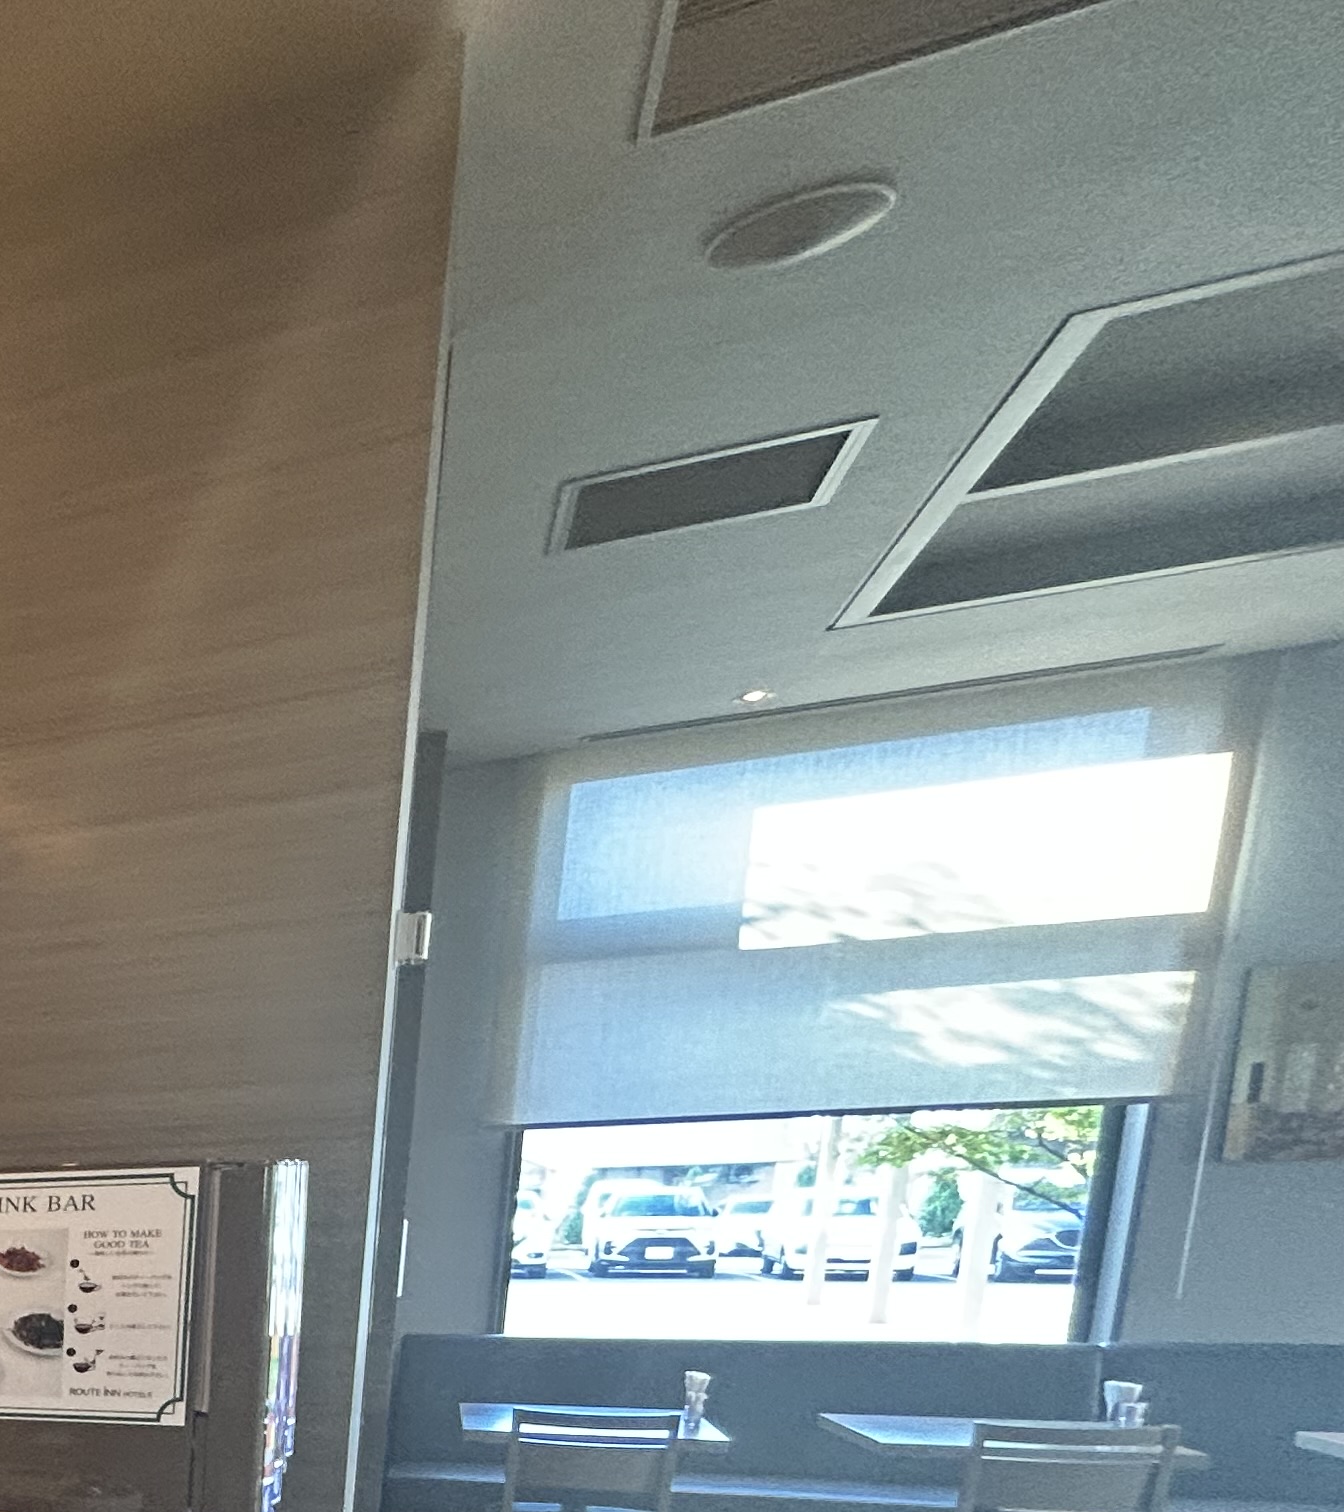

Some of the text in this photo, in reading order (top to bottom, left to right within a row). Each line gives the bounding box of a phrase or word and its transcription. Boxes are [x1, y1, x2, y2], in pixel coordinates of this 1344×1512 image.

[48, 1193, 97, 1213] BAR
[83, 1229, 162, 1239] HOW TO MAKE
[94, 1239, 150, 1249] GOOD TEA
[69, 1388, 101, 1397] ROUTE
